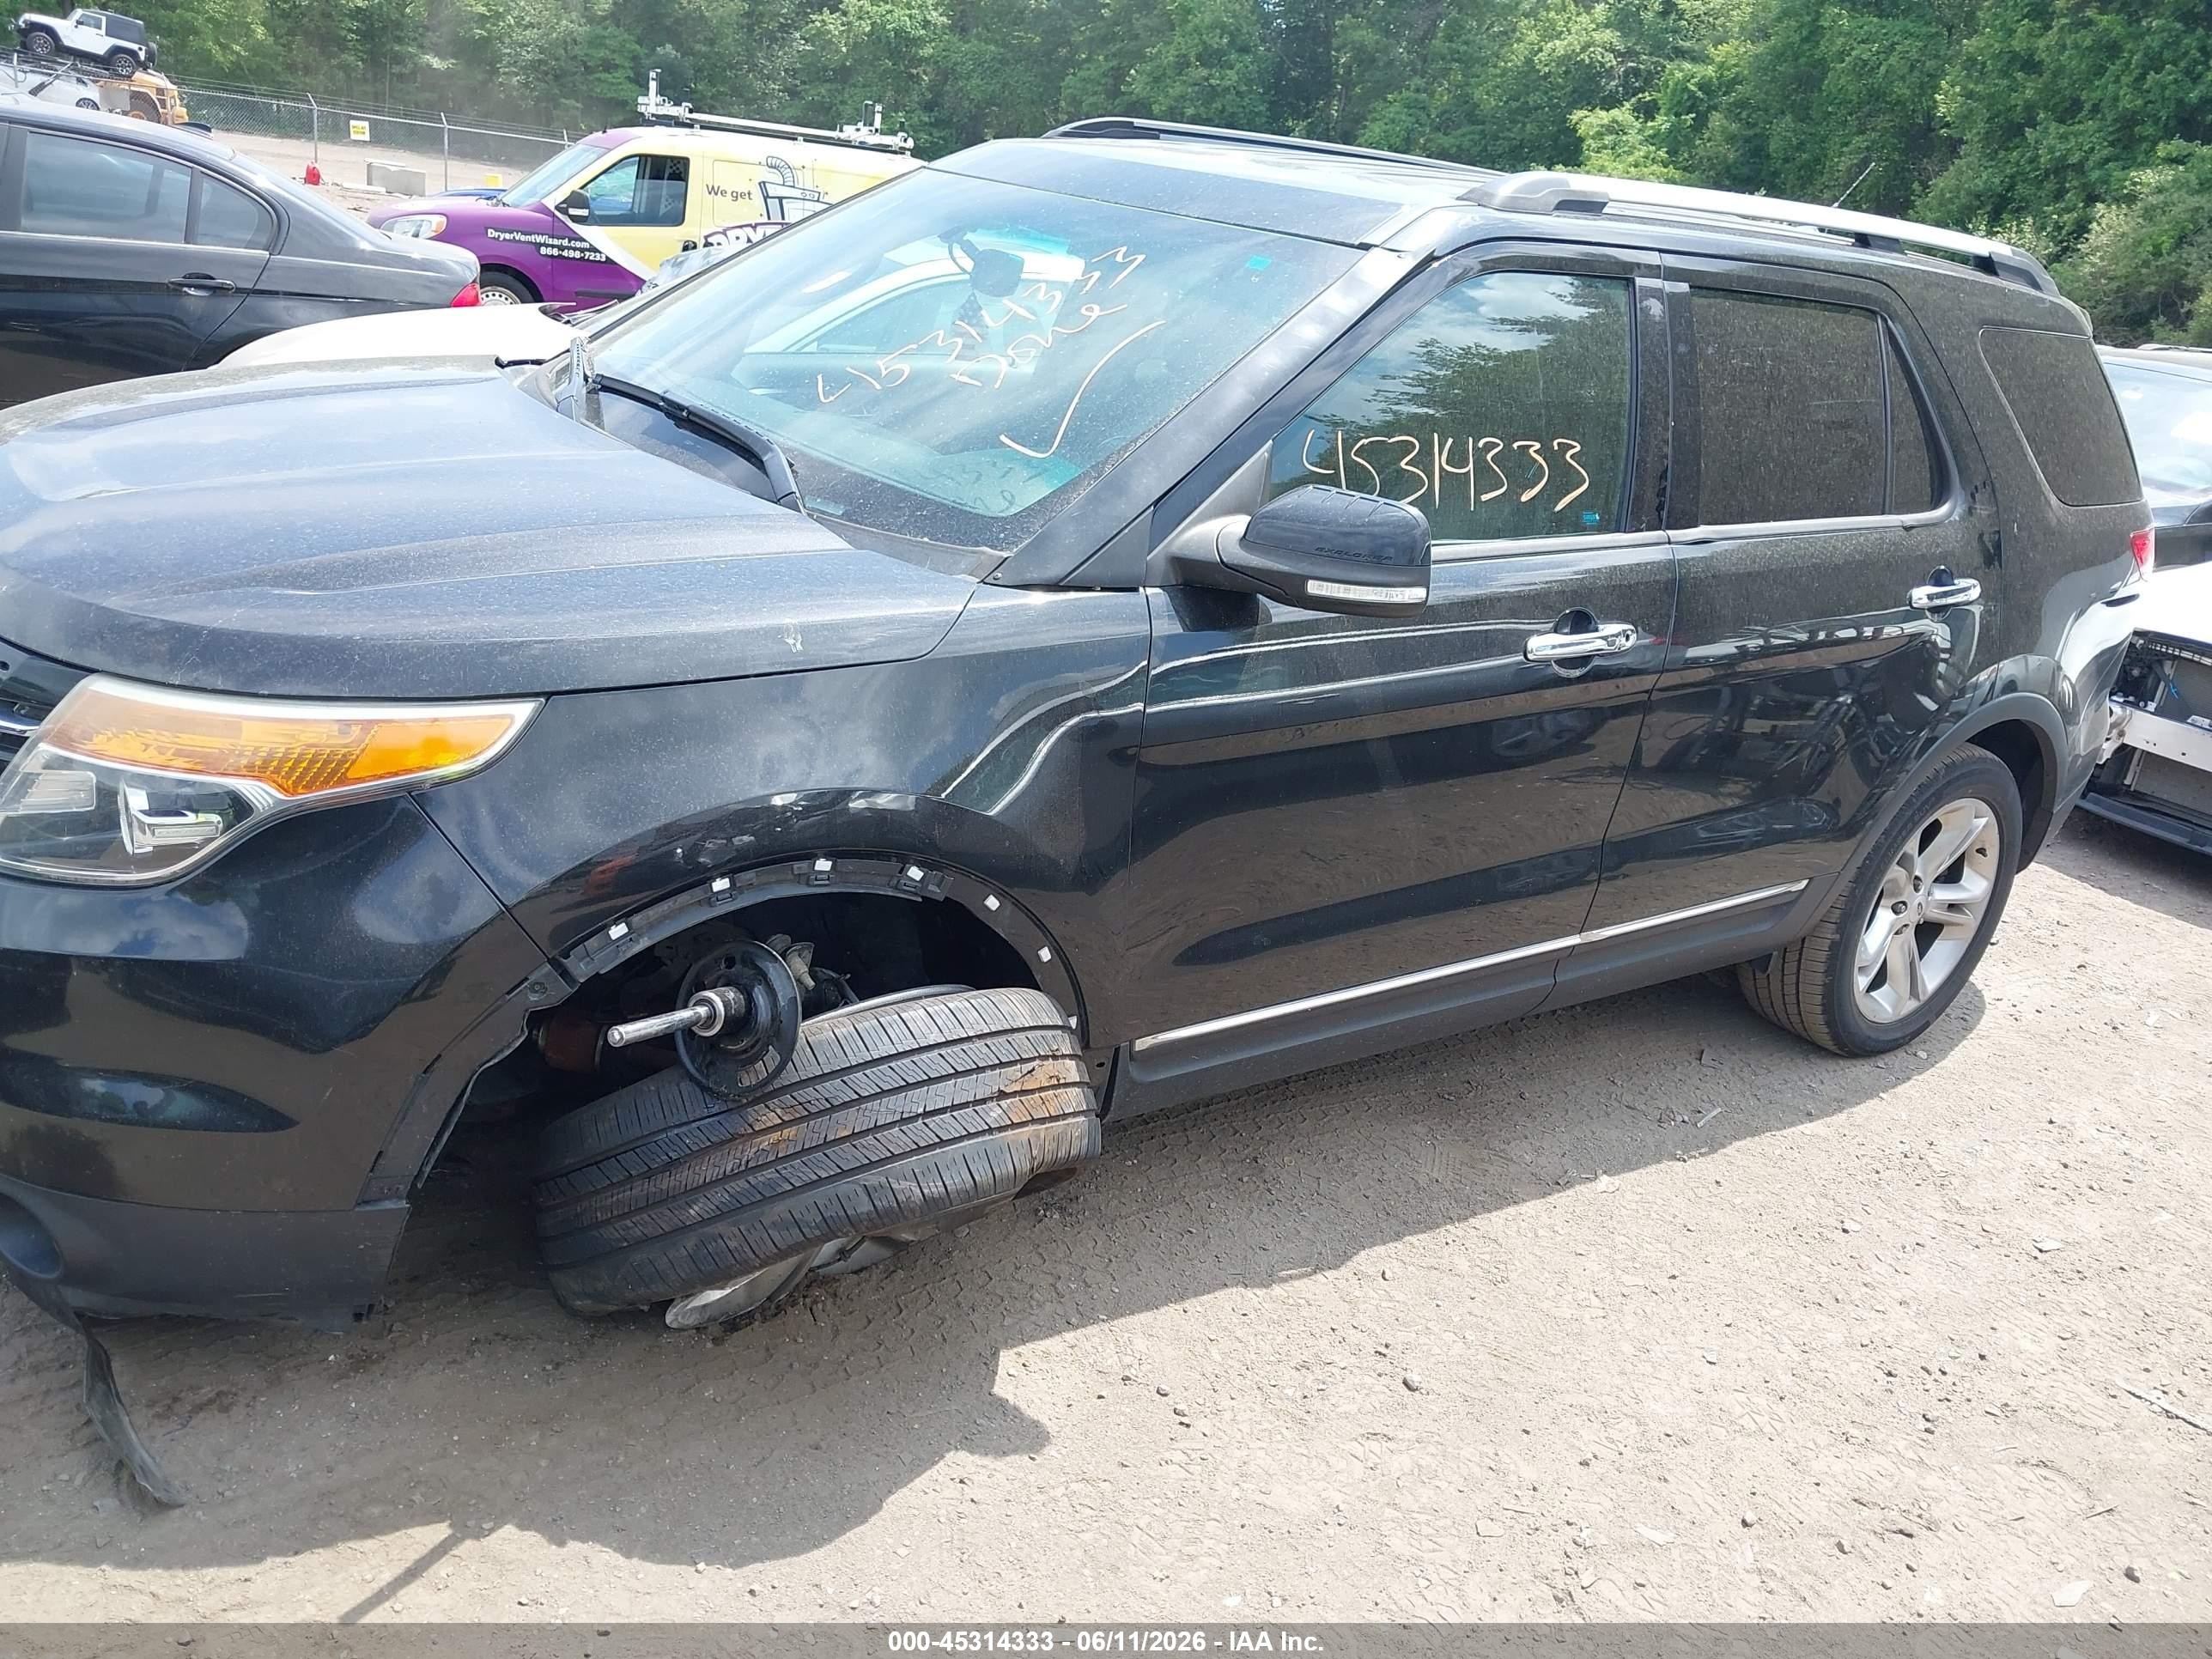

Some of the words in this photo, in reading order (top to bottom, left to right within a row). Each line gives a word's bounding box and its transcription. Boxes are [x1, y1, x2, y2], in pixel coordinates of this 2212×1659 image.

[706, 183, 728, 198] We
[731, 189, 753, 202] get
[487, 228, 591, 249] DryerVentWizard.com
[1302, 428, 1591, 514] 45314333
